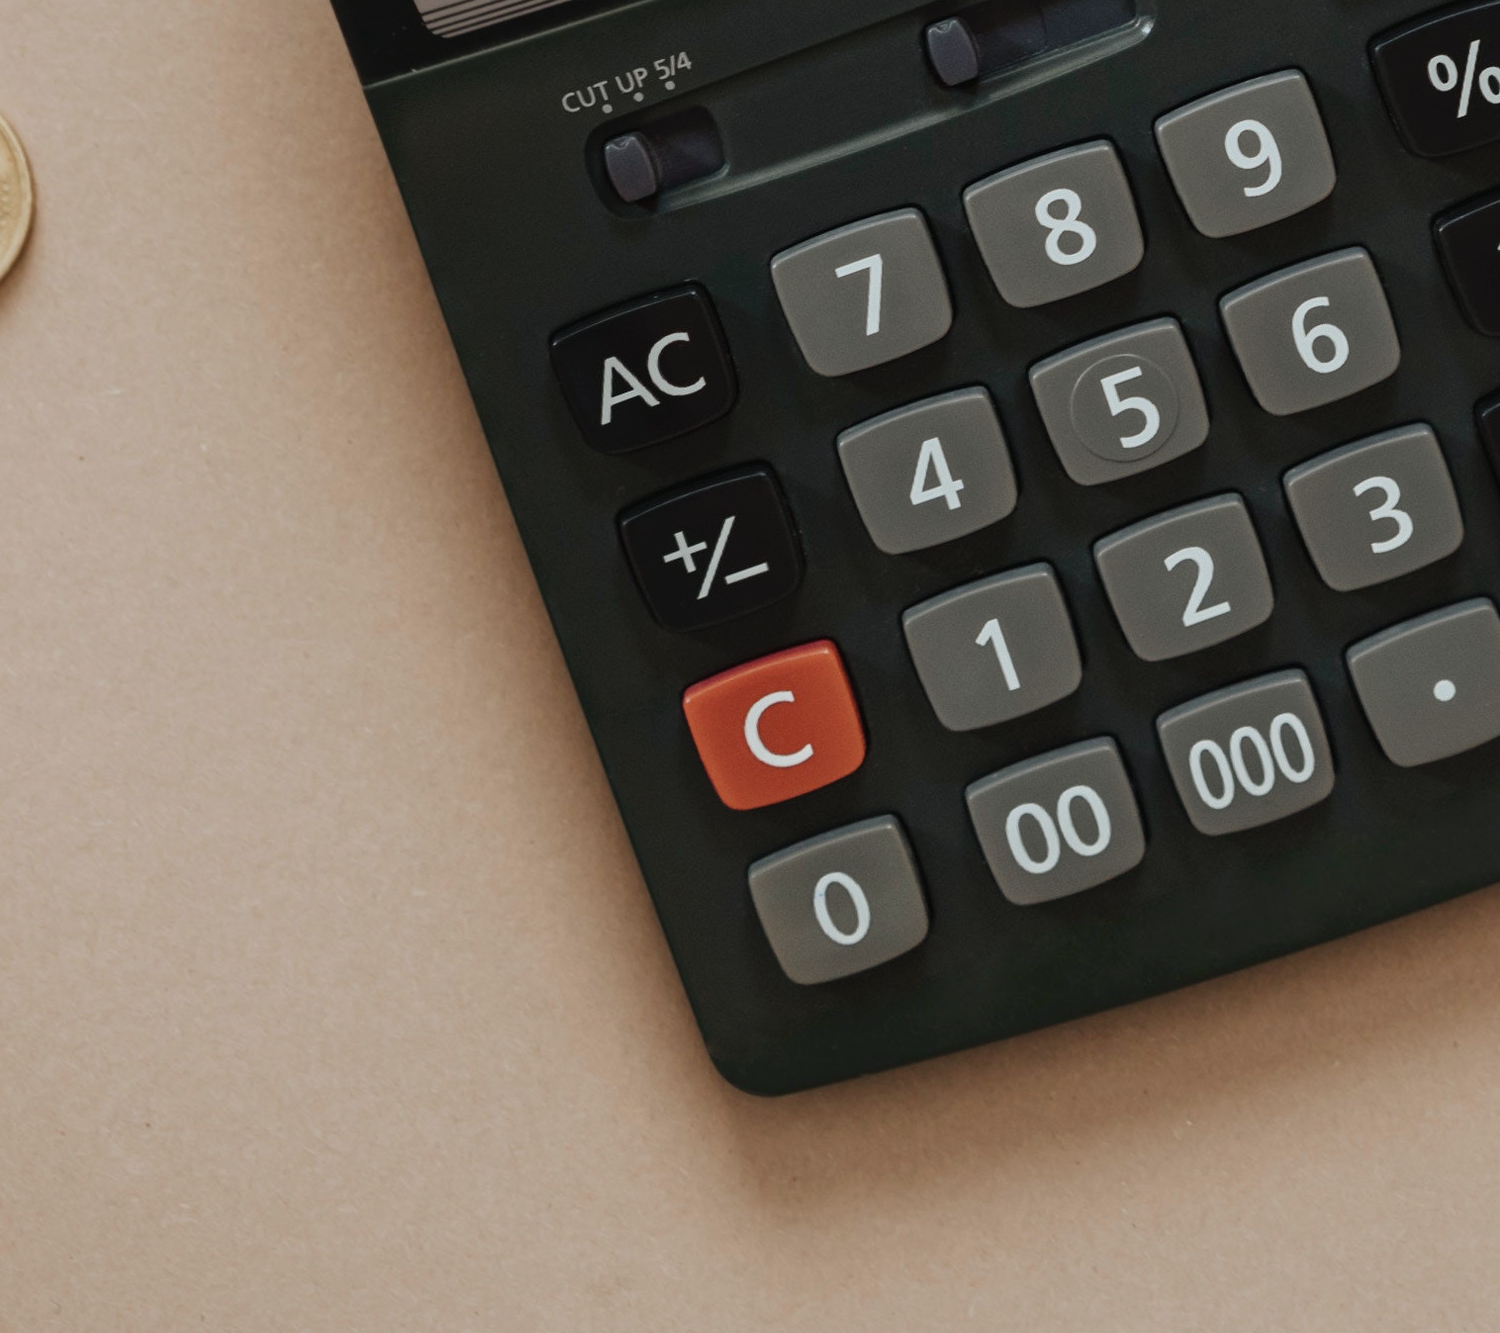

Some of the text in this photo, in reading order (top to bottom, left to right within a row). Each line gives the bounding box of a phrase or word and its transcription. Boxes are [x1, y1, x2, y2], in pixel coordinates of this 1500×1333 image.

[561, 51, 693, 114] CUT UP 5/4
[834, 119, 1282, 336] 7 8 9
[600, 331, 707, 426] AC
[909, 296, 1350, 510] 4 5 6
[975, 475, 1414, 691] 1 2 3
[744, 690, 814, 768] C
[813, 871, 871, 945] 0
[1005, 784, 1112, 874] 00
[1188, 712, 1315, 810] 000
